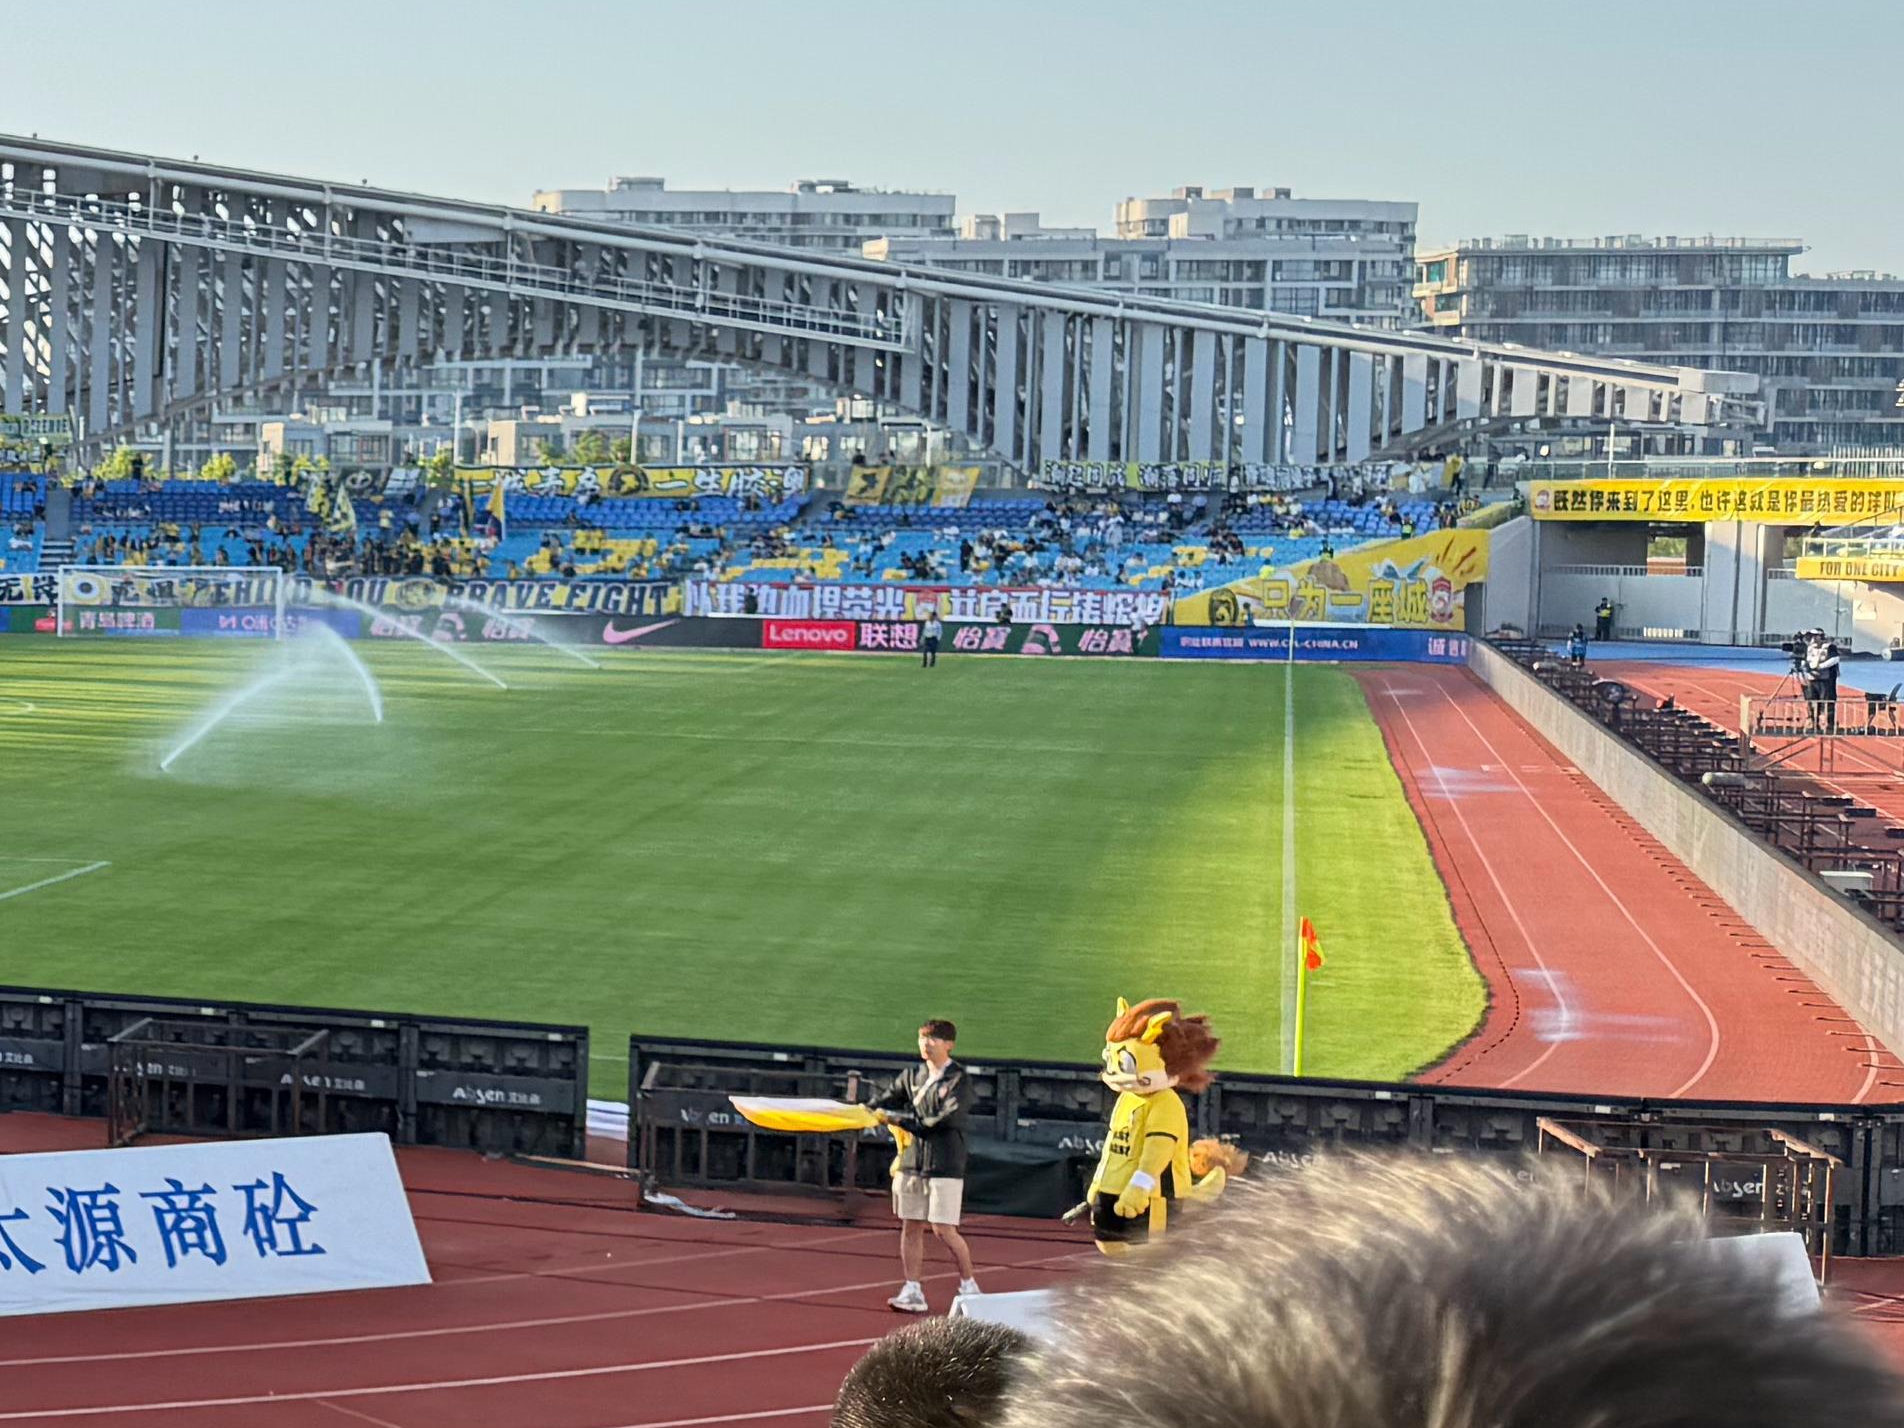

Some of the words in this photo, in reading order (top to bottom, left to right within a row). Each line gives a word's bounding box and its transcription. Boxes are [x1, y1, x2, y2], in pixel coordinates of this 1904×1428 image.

[1819, 562, 1843, 576] FOR
[1845, 562, 1869, 576] ONE
[1872, 562, 1899, 577] CITY
[564, 582, 671, 615] FIGHT
[1262, 577, 1428, 623] 只为一座城
[769, 623, 849, 643] Lenovo
[859, 623, 919, 649] 联想
